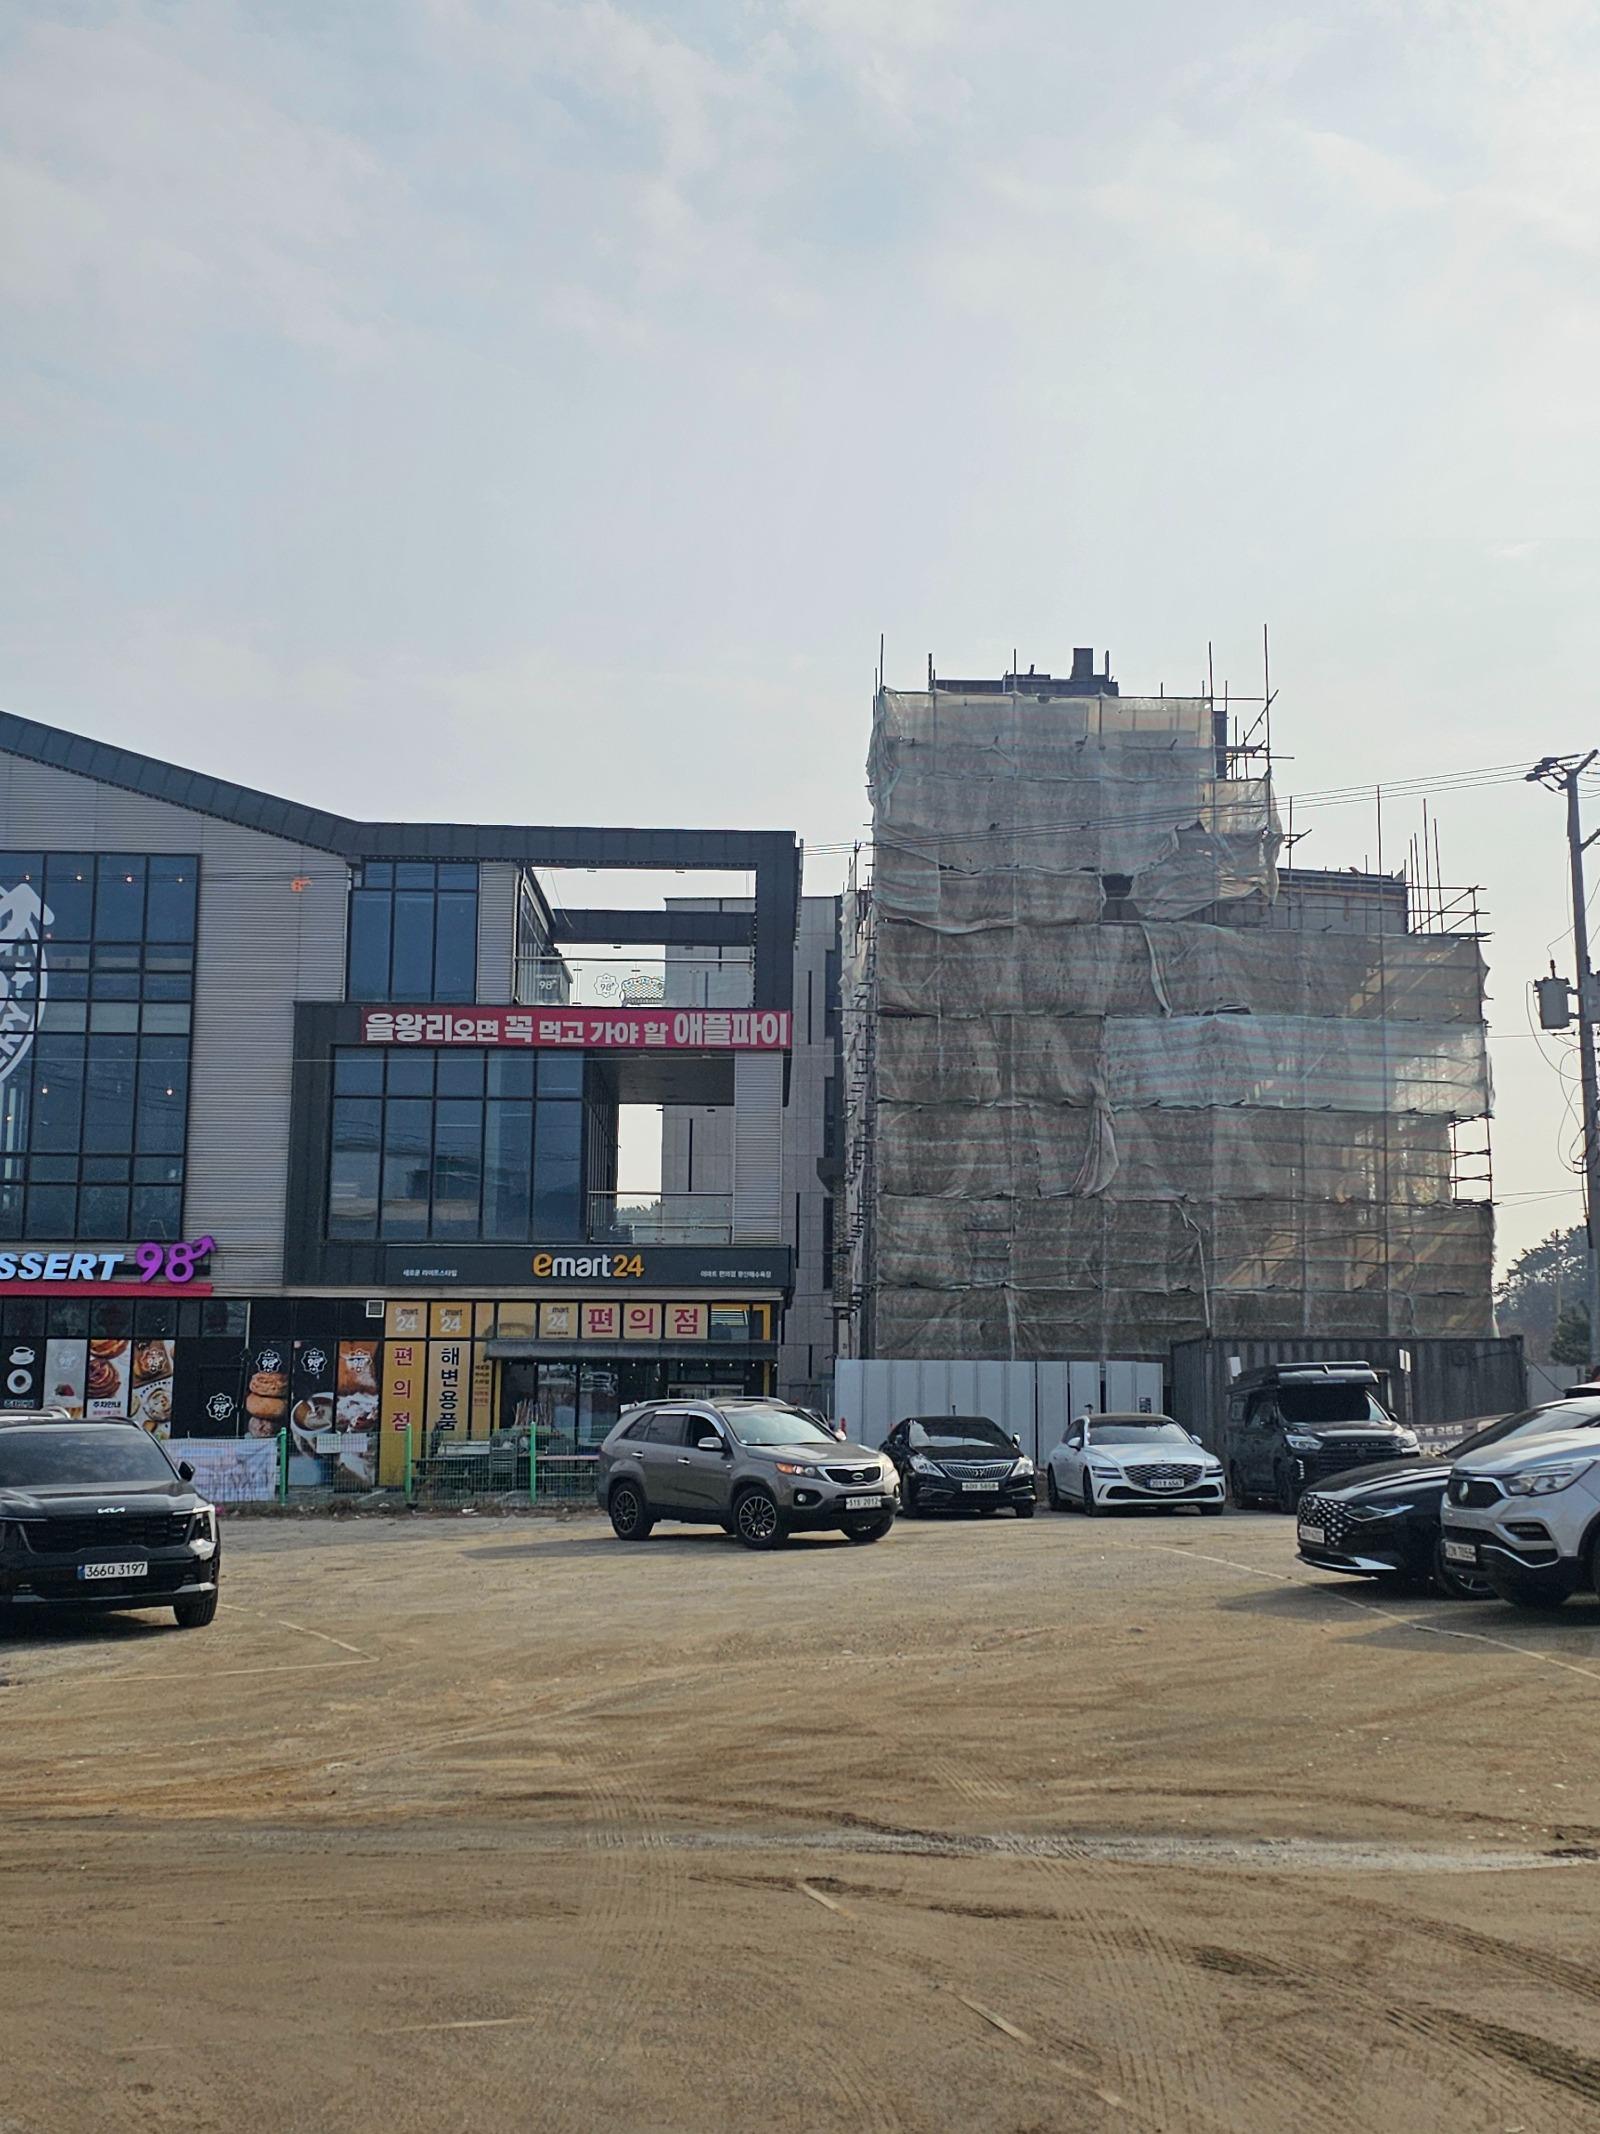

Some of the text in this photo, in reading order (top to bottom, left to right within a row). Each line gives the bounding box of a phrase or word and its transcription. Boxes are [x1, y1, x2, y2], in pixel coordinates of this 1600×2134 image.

[505, 1015, 533, 1043] 꼭
[539, 1021, 585, 1043] 먹고
[590, 1022, 639, 1044] 가야
[643, 1022, 668, 1044] 할
[674, 1013, 787, 1045] 애플파이
[135, 1239, 205, 1283] 98
[533, 1253, 645, 1278] emart24
[396, 1315, 417, 1332] 24
[441, 1315, 461, 1332] 24
[547, 1313, 568, 1329] 24
[118, 1563, 145, 1575] 3197
